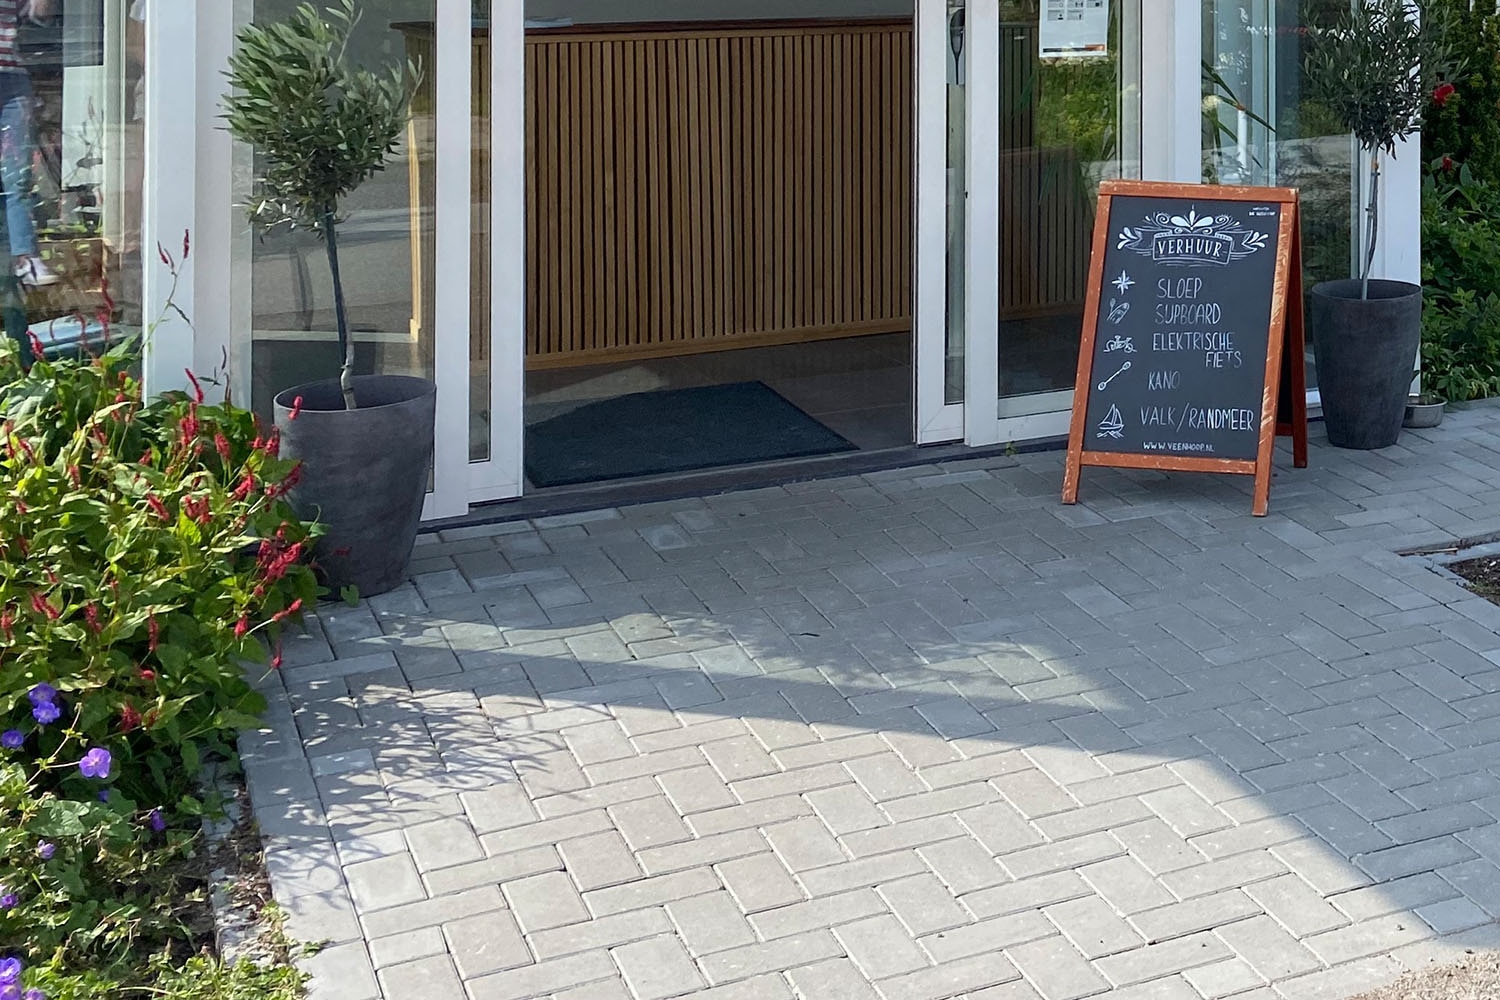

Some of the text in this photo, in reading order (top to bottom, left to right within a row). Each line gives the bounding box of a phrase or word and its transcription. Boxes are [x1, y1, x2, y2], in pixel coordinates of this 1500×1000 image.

[1158, 238, 1222, 257] VERHUUR
[1157, 277, 1202, 299] SLOEP
[1155, 303, 1221, 325] SUPBOARD
[1153, 332, 1235, 351] ELEKTRISCHE
[1206, 350, 1242, 368] FIETS
[1148, 371, 1180, 391] KANO
